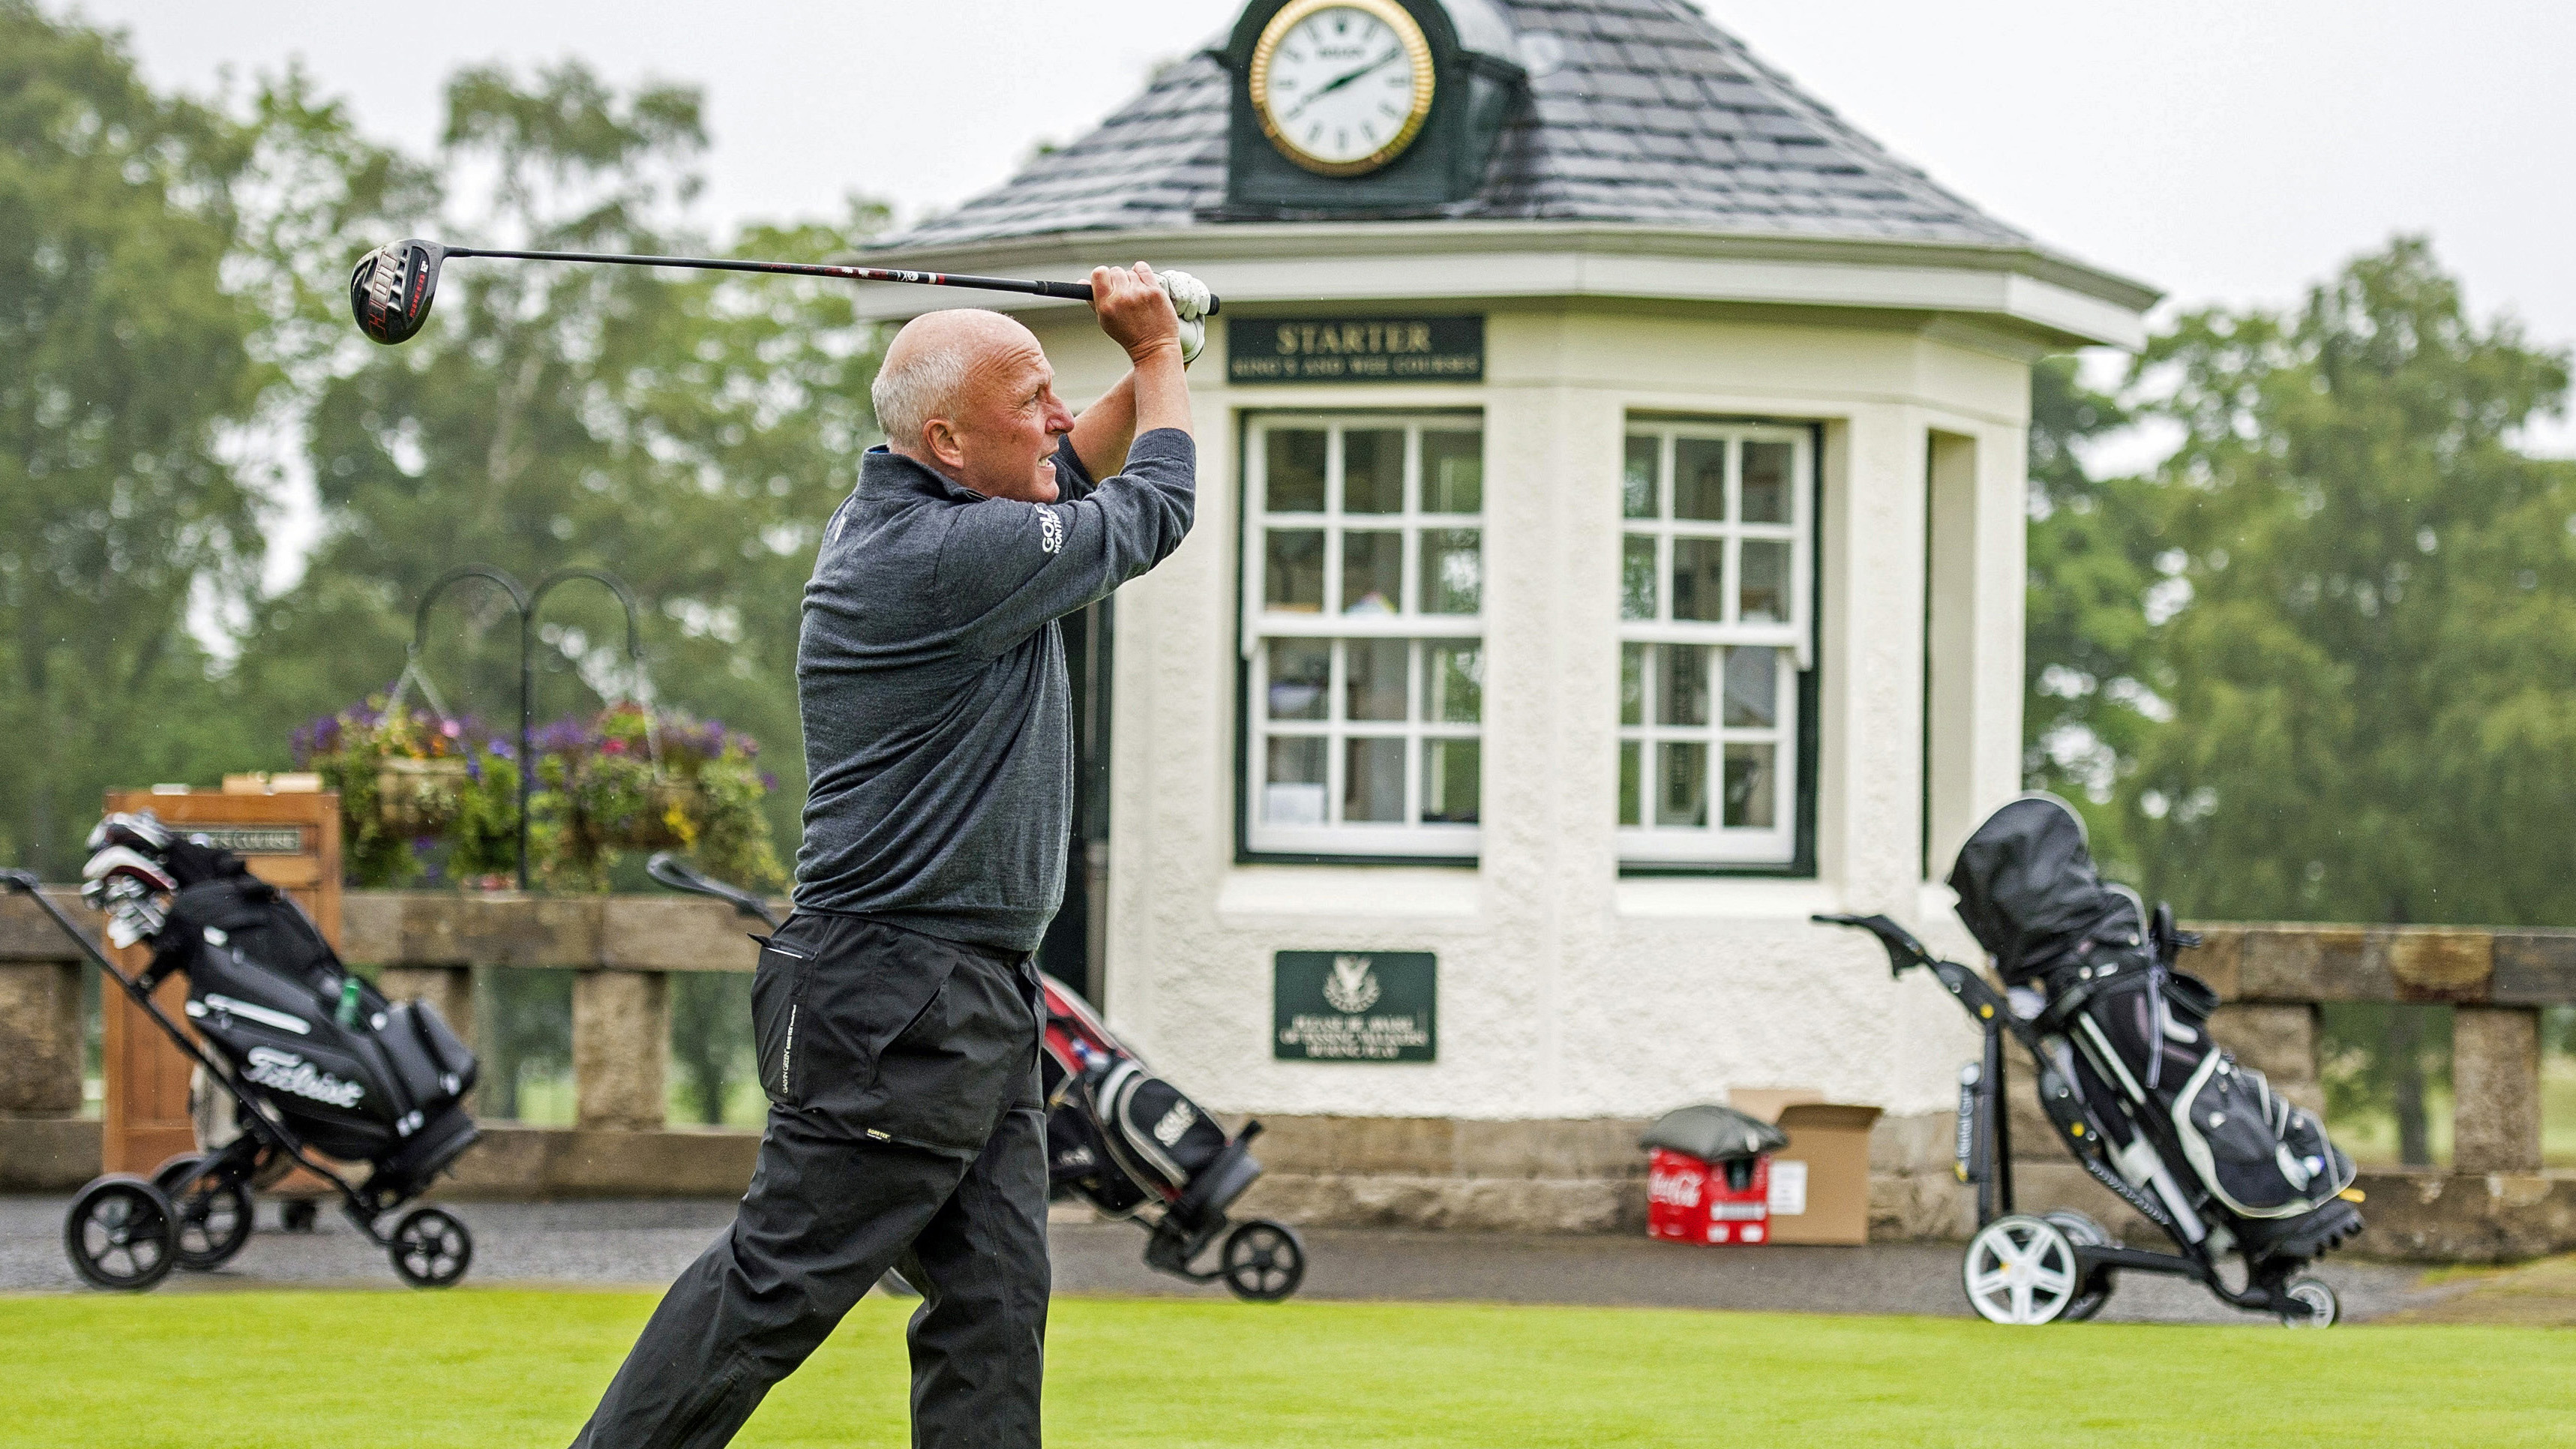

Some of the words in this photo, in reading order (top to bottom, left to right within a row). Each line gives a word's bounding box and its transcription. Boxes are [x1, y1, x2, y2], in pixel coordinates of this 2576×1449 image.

[1276, 323, 1431, 353] STARTER
[1303, 356, 1344, 374] AND
[1034, 505, 1054, 552] GOLF
[241, 1046, 364, 1107] Titleist
